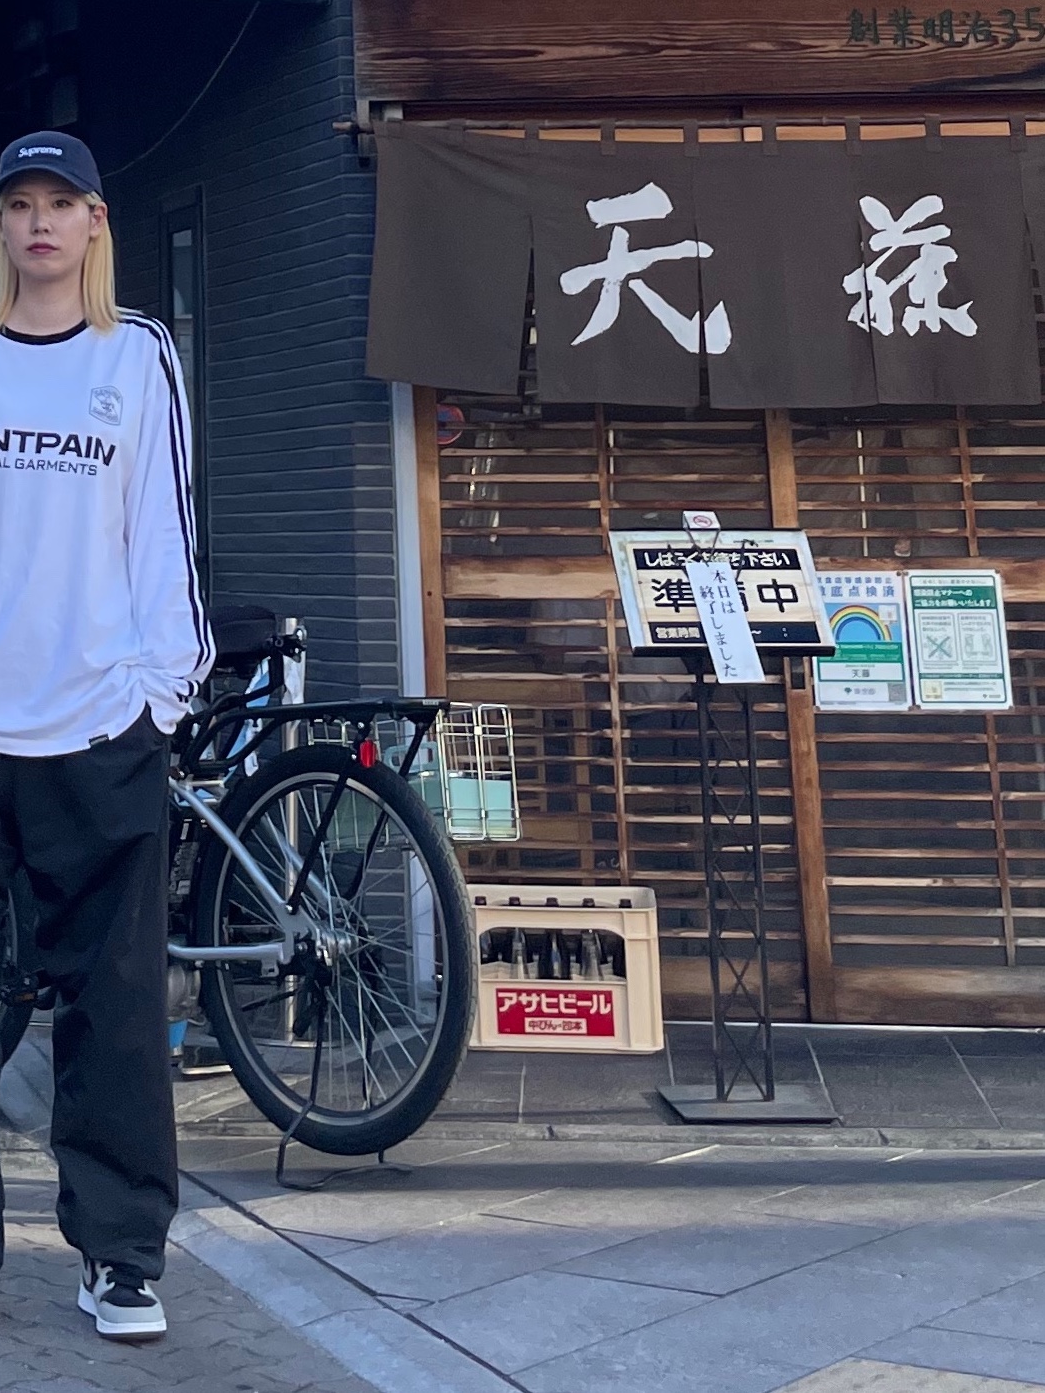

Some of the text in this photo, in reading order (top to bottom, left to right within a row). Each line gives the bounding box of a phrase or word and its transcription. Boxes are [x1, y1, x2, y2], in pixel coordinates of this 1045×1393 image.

[18, 147, 63, 158] Supreme
[14, 458, 97, 476] GARMENTS
[651, 578, 799, 613] 準中
[497, 992, 611, 1015] アサヒビール
